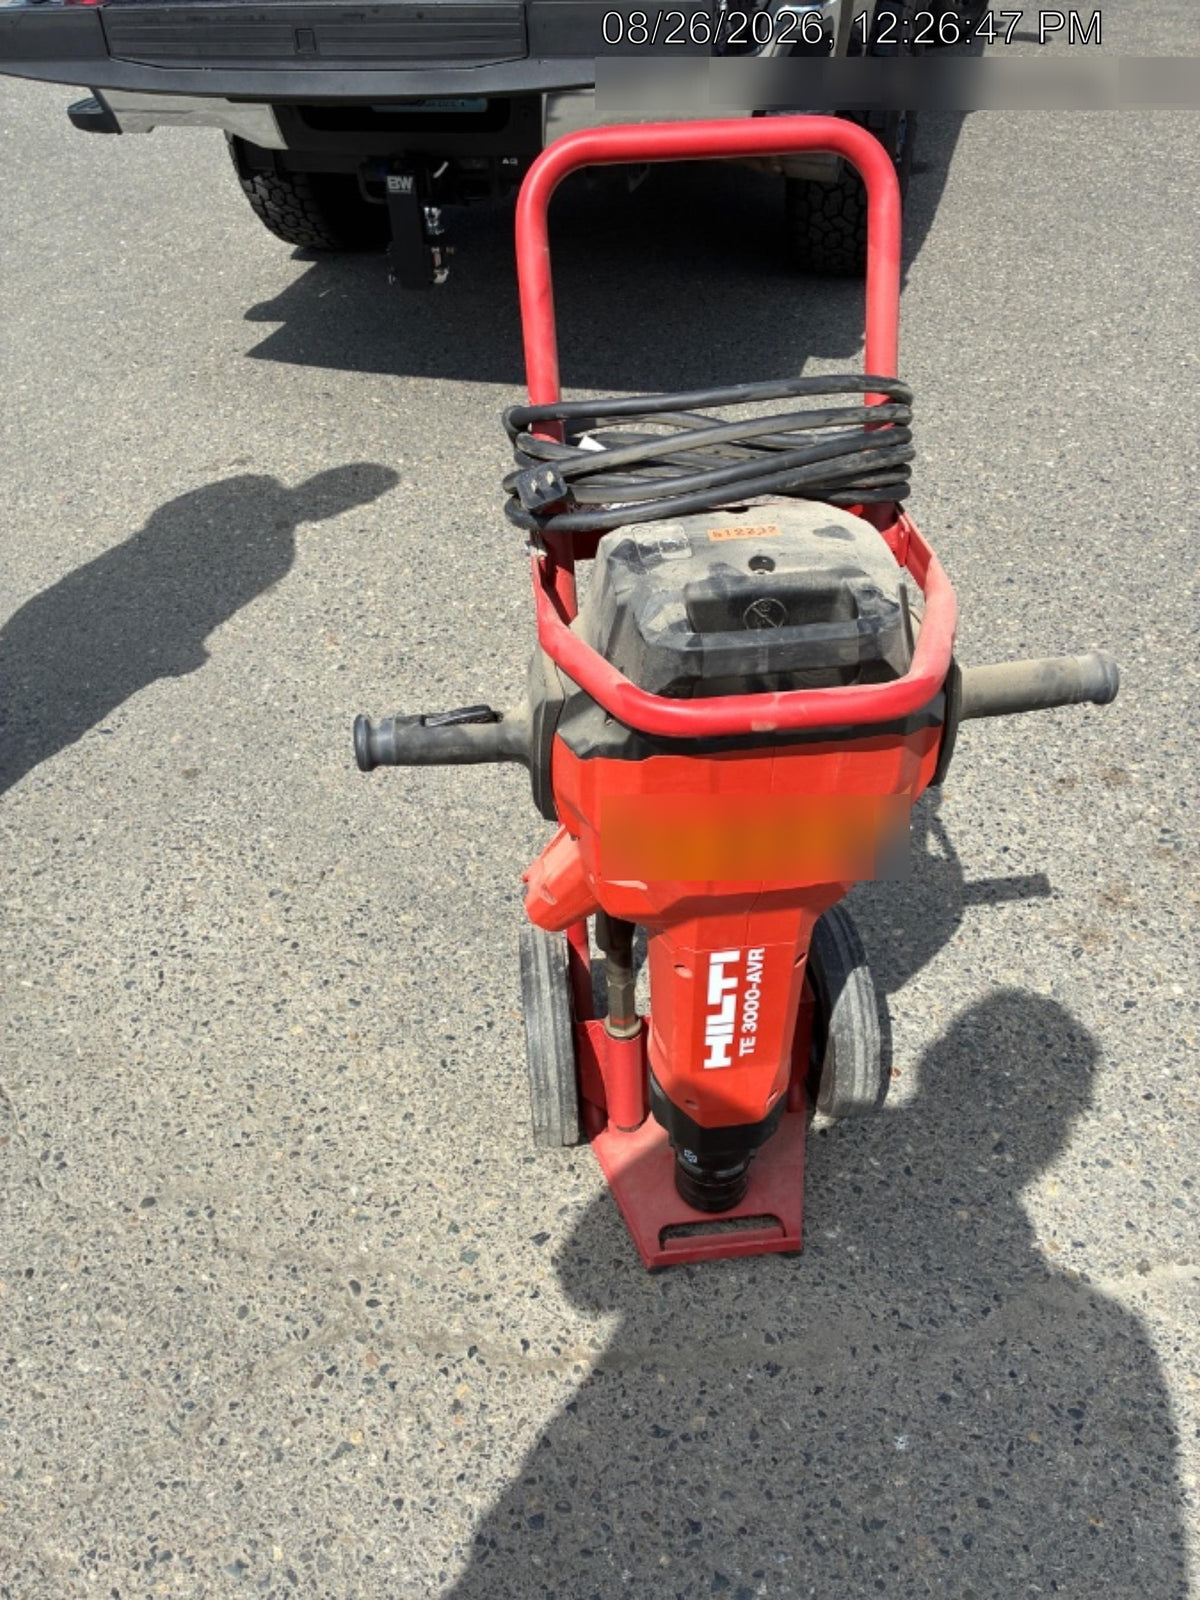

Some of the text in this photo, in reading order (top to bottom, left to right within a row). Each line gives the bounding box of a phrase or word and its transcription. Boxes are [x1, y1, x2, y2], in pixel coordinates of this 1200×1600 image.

[703, 950, 740, 1069] HILTI
[739, 948, 765, 1057] TE 3000-AVR
